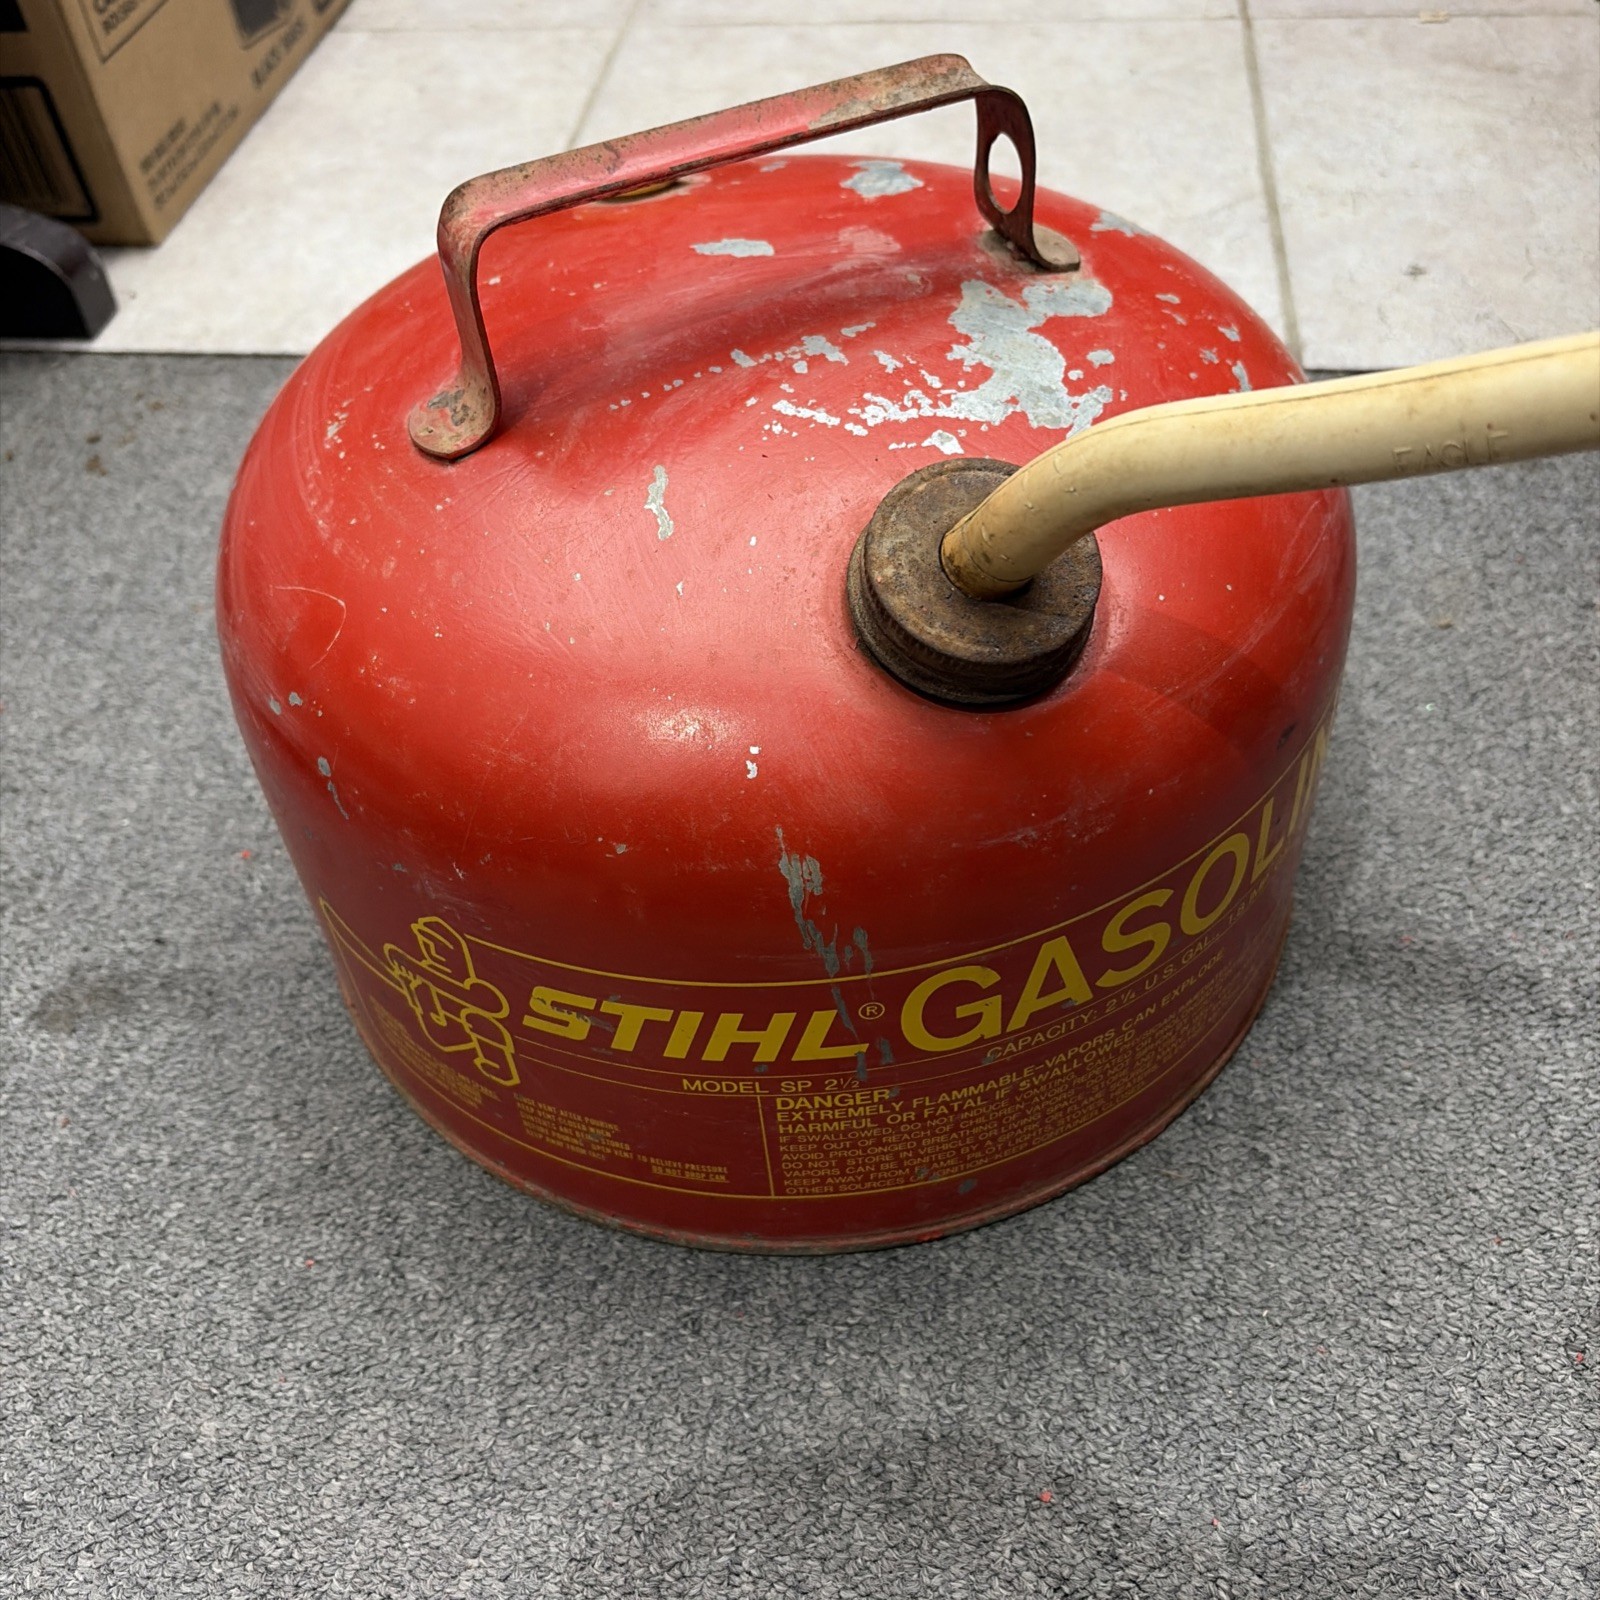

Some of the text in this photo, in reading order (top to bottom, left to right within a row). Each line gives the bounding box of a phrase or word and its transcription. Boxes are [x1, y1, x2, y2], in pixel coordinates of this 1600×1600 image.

[521, 985, 870, 1062] STIHL
[777, 1101, 904, 1122] EXTREMELY
[1122, 1002, 1157, 1031] CAN
[1161, 946, 1225, 1008] EXPLODE
[986, 1009, 1098, 1059] CAPACITY:
[682, 1078, 770, 1094] MODEL
[780, 1080, 812, 1093] SP
[776, 1089, 890, 1110] DANGER
[779, 1118, 878, 1134] HARMFUL
[886, 1111, 915, 1124] OR
[924, 1096, 988, 1118] FATAL
[996, 1085, 1012, 1100] IF
[1019, 1029, 1136, 1091] SWALLOWED
[779, 1135, 791, 1143] IF
[900, 1122, 921, 1132] DO
[927, 1114, 956, 1127] NOT
[960, 1099, 1009, 1120] INDUCE
[779, 1144, 818, 1152] KEEP
[822, 1141, 853, 1151] OUT
[857, 1138, 877, 1147] OF
[882, 1130, 931, 1144] REACH
[935, 1124, 955, 1134] OF
[781, 1152, 824, 1160] AVOID
[829, 1141, 917, 1159] PROLONGED
[921, 1121, 998, 1146] BREATHING
[781, 1161, 803, 1169] DO
[808, 1160, 838, 1168] NOT
[846, 1153, 895, 1166] STORE
[899, 1150, 913, 1158] IN
[918, 1136, 975, 1155] VEHICLE
[978, 1129, 998, 1141] OR
[1001, 1113, 1041, 1133] LIVING
[783, 1168, 840, 1177] VAPORS
[845, 1165, 875, 1174] CAN
[880, 1161, 899, 1171] BE
[903, 1150, 956, 1167] IGNITED
[960, 1143, 980, 1155] BY
[984, 1139, 993, 1148] A
[784, 1178, 821, 1186] KEEP
[825, 1174, 864, 1184] AWAY
[870, 1167, 910, 1180] FROM
[786, 1185, 834, 1195] OTHER
[839, 1177, 905, 1192] SOURCES
